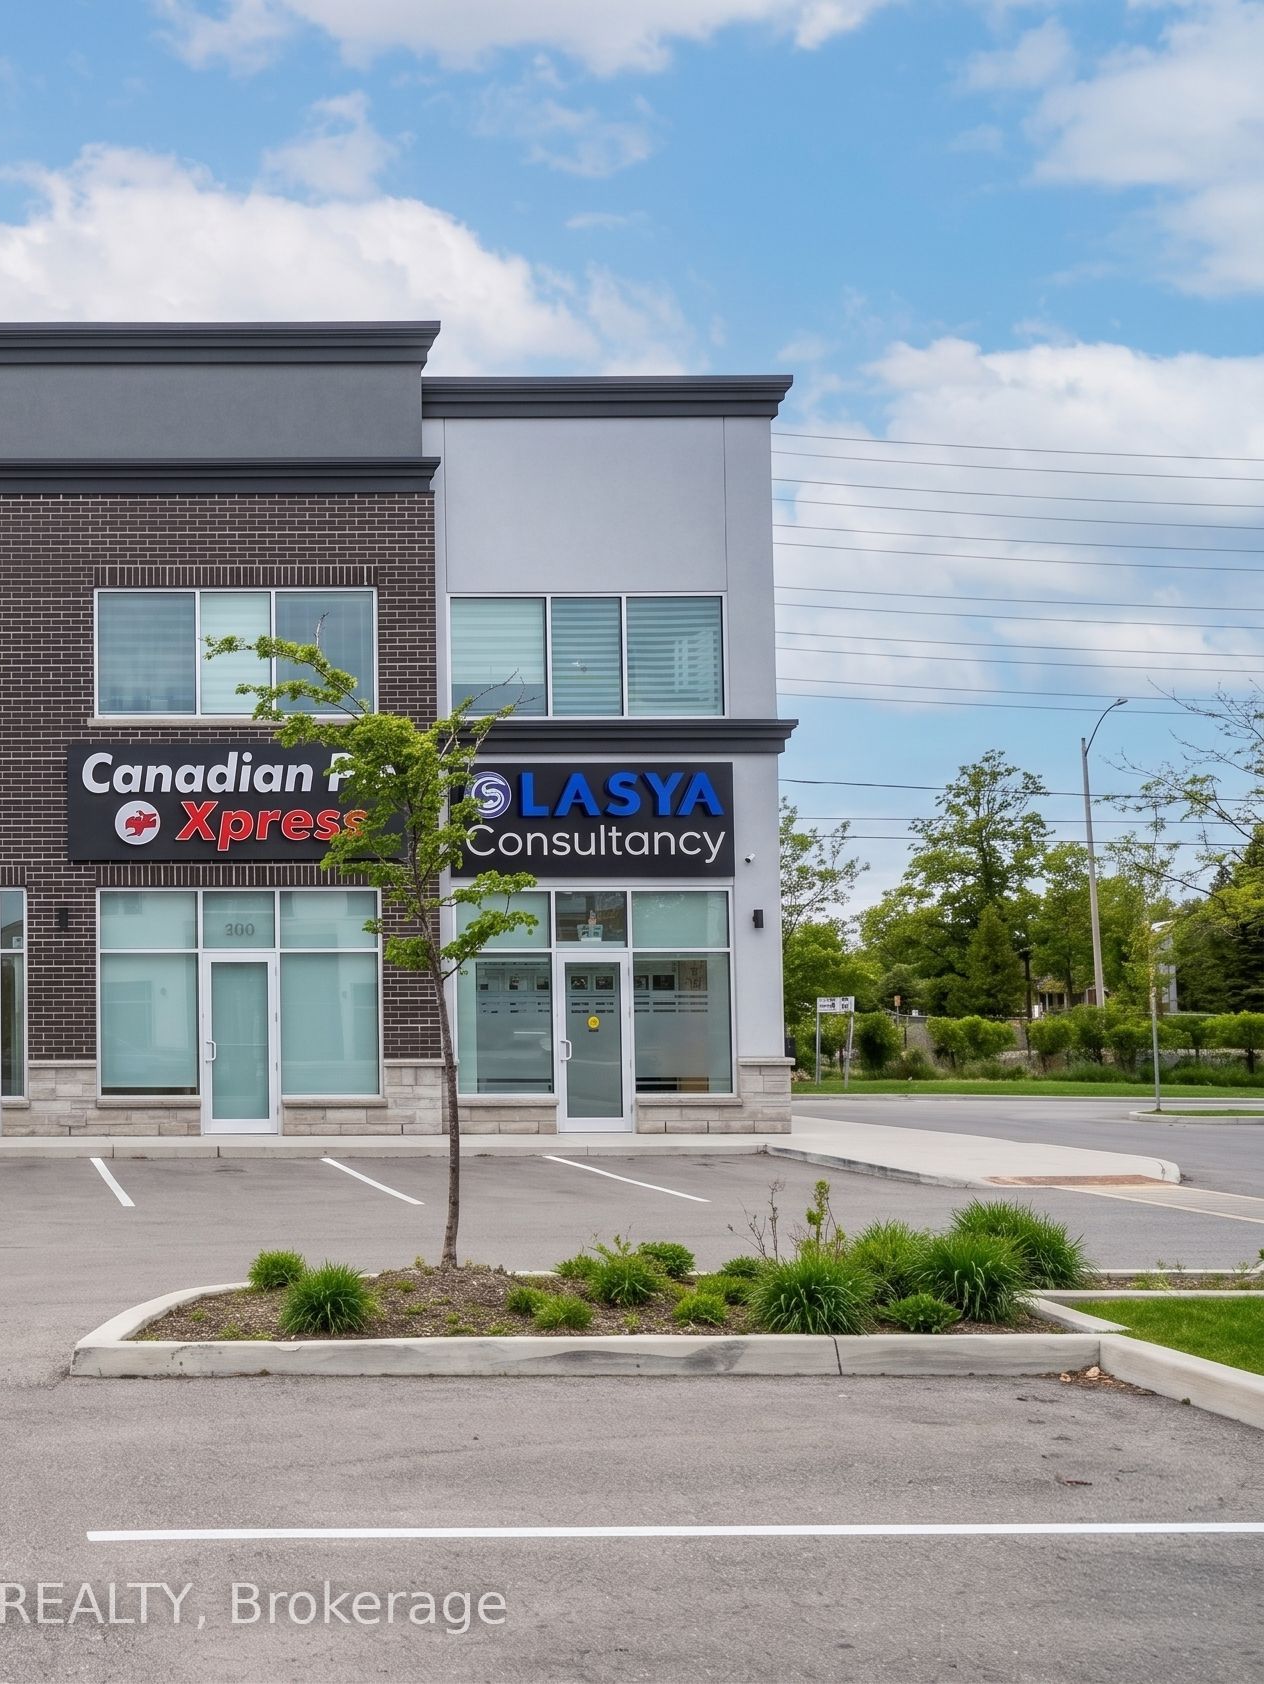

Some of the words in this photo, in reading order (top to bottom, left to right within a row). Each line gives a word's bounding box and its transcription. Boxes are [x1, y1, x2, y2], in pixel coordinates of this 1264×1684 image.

[82, 751, 313, 793] Canadian
[519, 771, 725, 817] LASYA
[175, 800, 368, 851] Xpress
[466, 824, 726, 864] Consultancy
